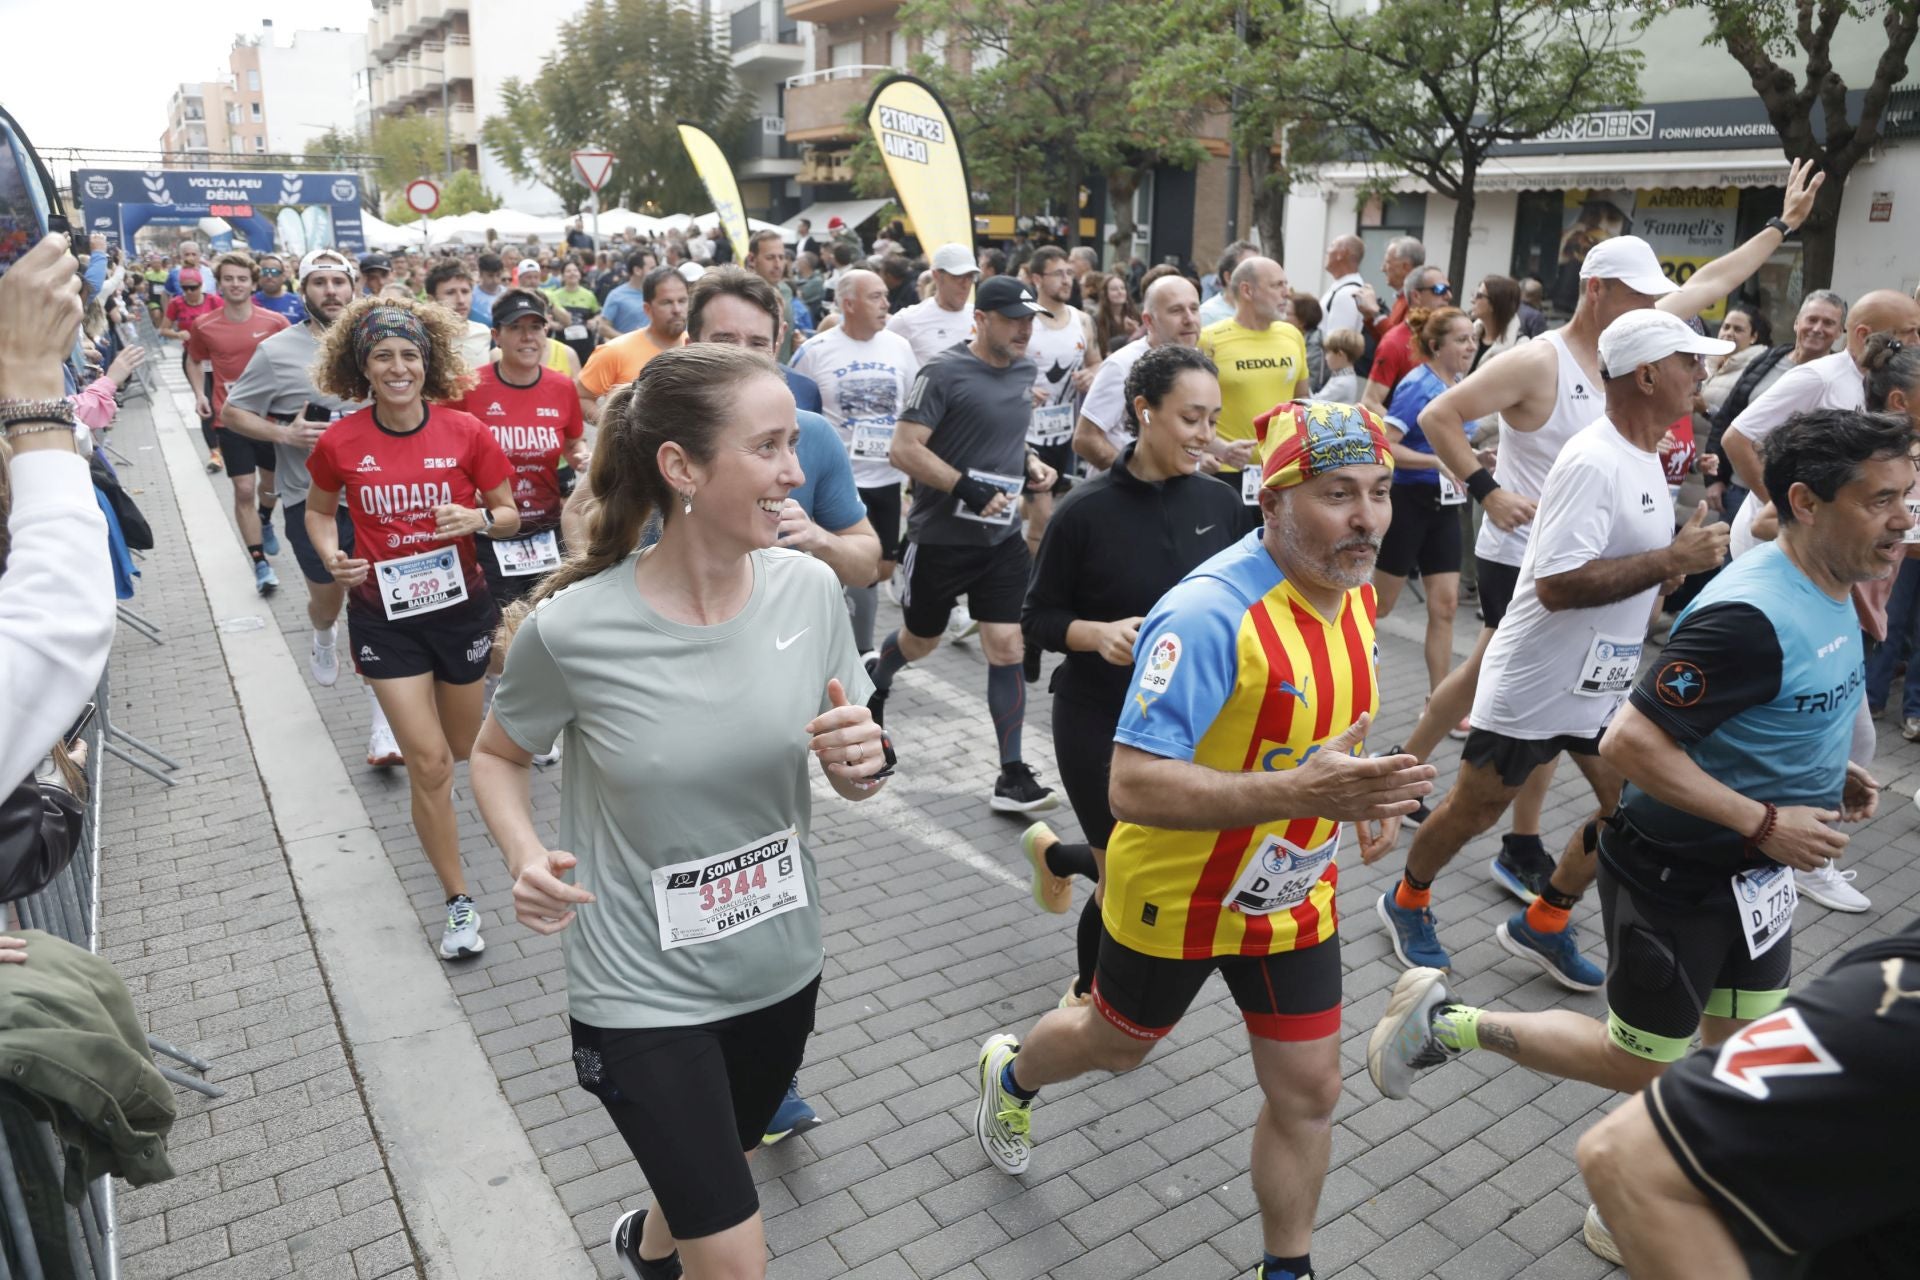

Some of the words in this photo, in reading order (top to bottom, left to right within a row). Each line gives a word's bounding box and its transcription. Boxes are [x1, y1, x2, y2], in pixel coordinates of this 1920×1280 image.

[189, 178, 227, 189] VOLTA
[227, 178, 236, 189] A
[237, 178, 262, 189] PEU
[206, 188, 248, 200] DÉNIA
[1648, 193, 1724, 207] APERTURA
[1644, 217, 1724, 236] Fanneli's
[833, 361, 896, 378] DÉNIA
[360, 481, 452, 515] ONDARA
[392, 588, 402, 600] C
[409, 578, 440, 598] 239
[408, 591, 449, 608] BALEARIA
[1592, 666, 1602, 679] F
[1607, 667, 1629, 681] 884
[707, 861, 737, 880] SOM
[740, 840, 786, 868] ESPORT
[699, 863, 768, 911] 3344
[1250, 876, 1270, 892] D
[706, 912, 727, 924] VOLTA
[744, 900, 758, 909] PEU
[1752, 909, 1763, 928] D
[1767, 884, 1790, 918] 778
[717, 905, 761, 930] DÉNIA
